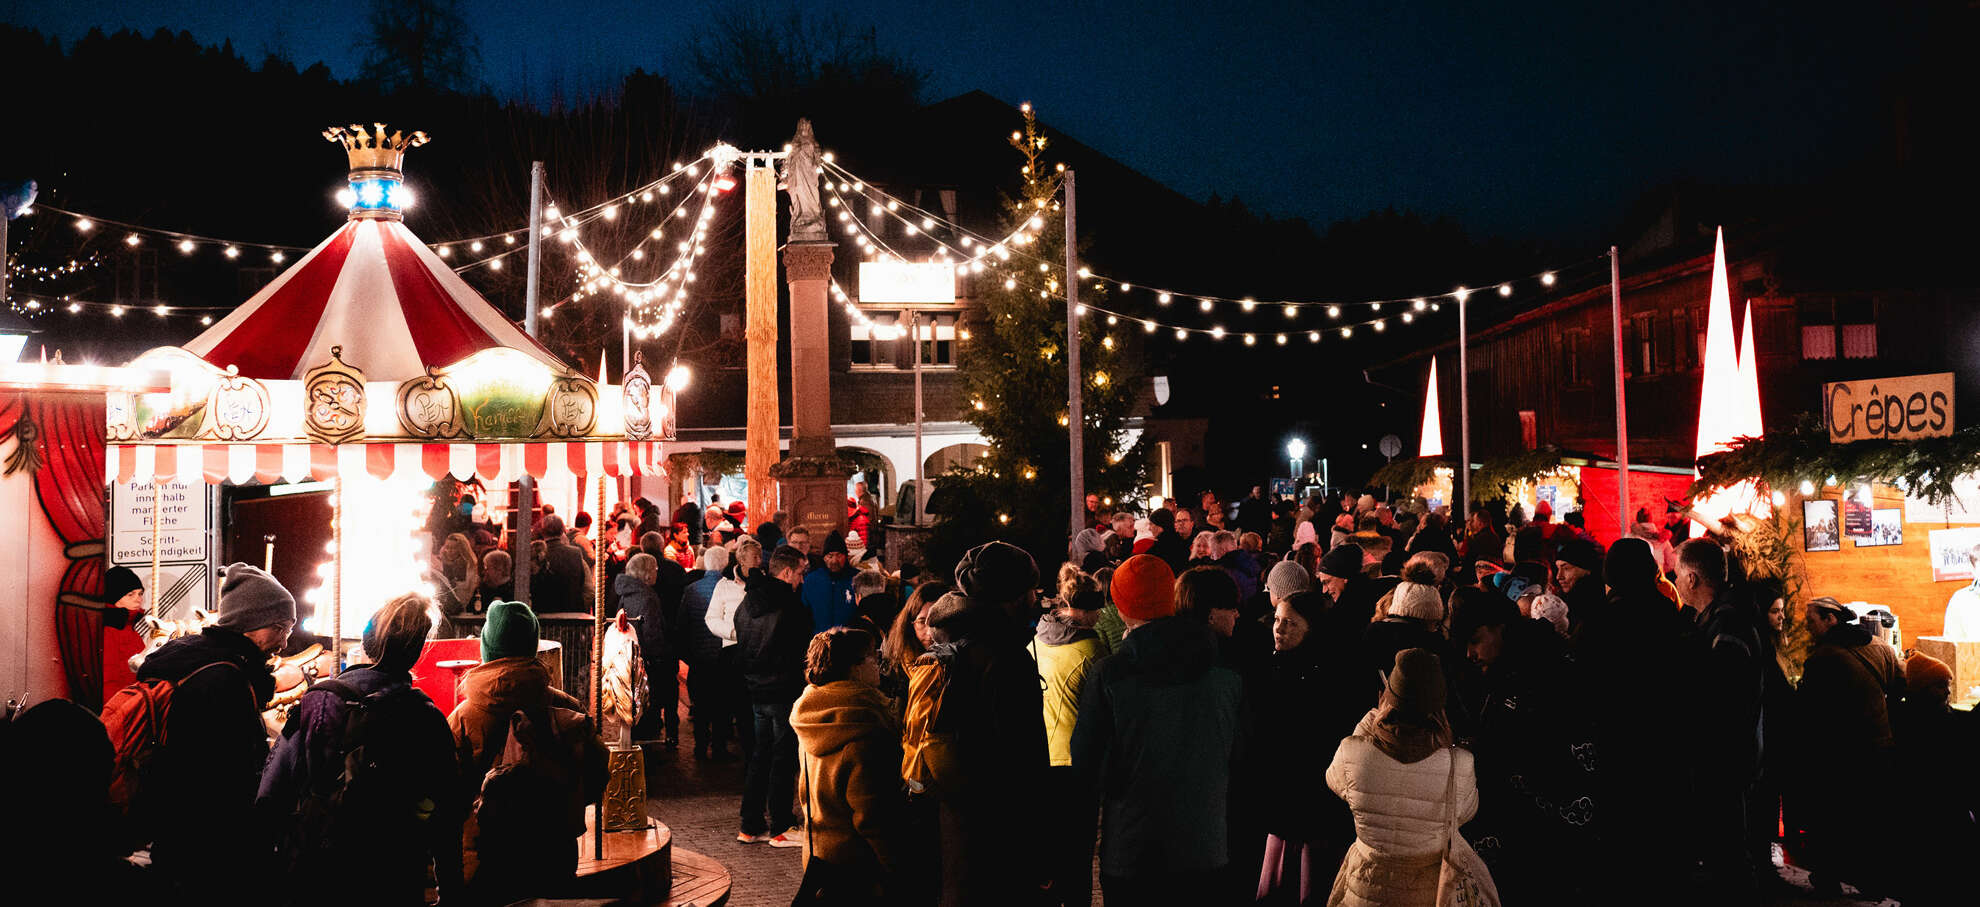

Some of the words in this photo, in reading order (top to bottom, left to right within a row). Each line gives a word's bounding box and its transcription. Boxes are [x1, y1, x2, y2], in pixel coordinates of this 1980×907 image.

[1830, 383, 1947, 439] Crêpes
[131, 482, 168, 491] Parkn
[132, 505, 188, 514] marerter
[143, 516, 178, 526] Flche
[140, 536, 180, 545] Scritt-
[117, 546, 202, 560] geschwndigkeit
